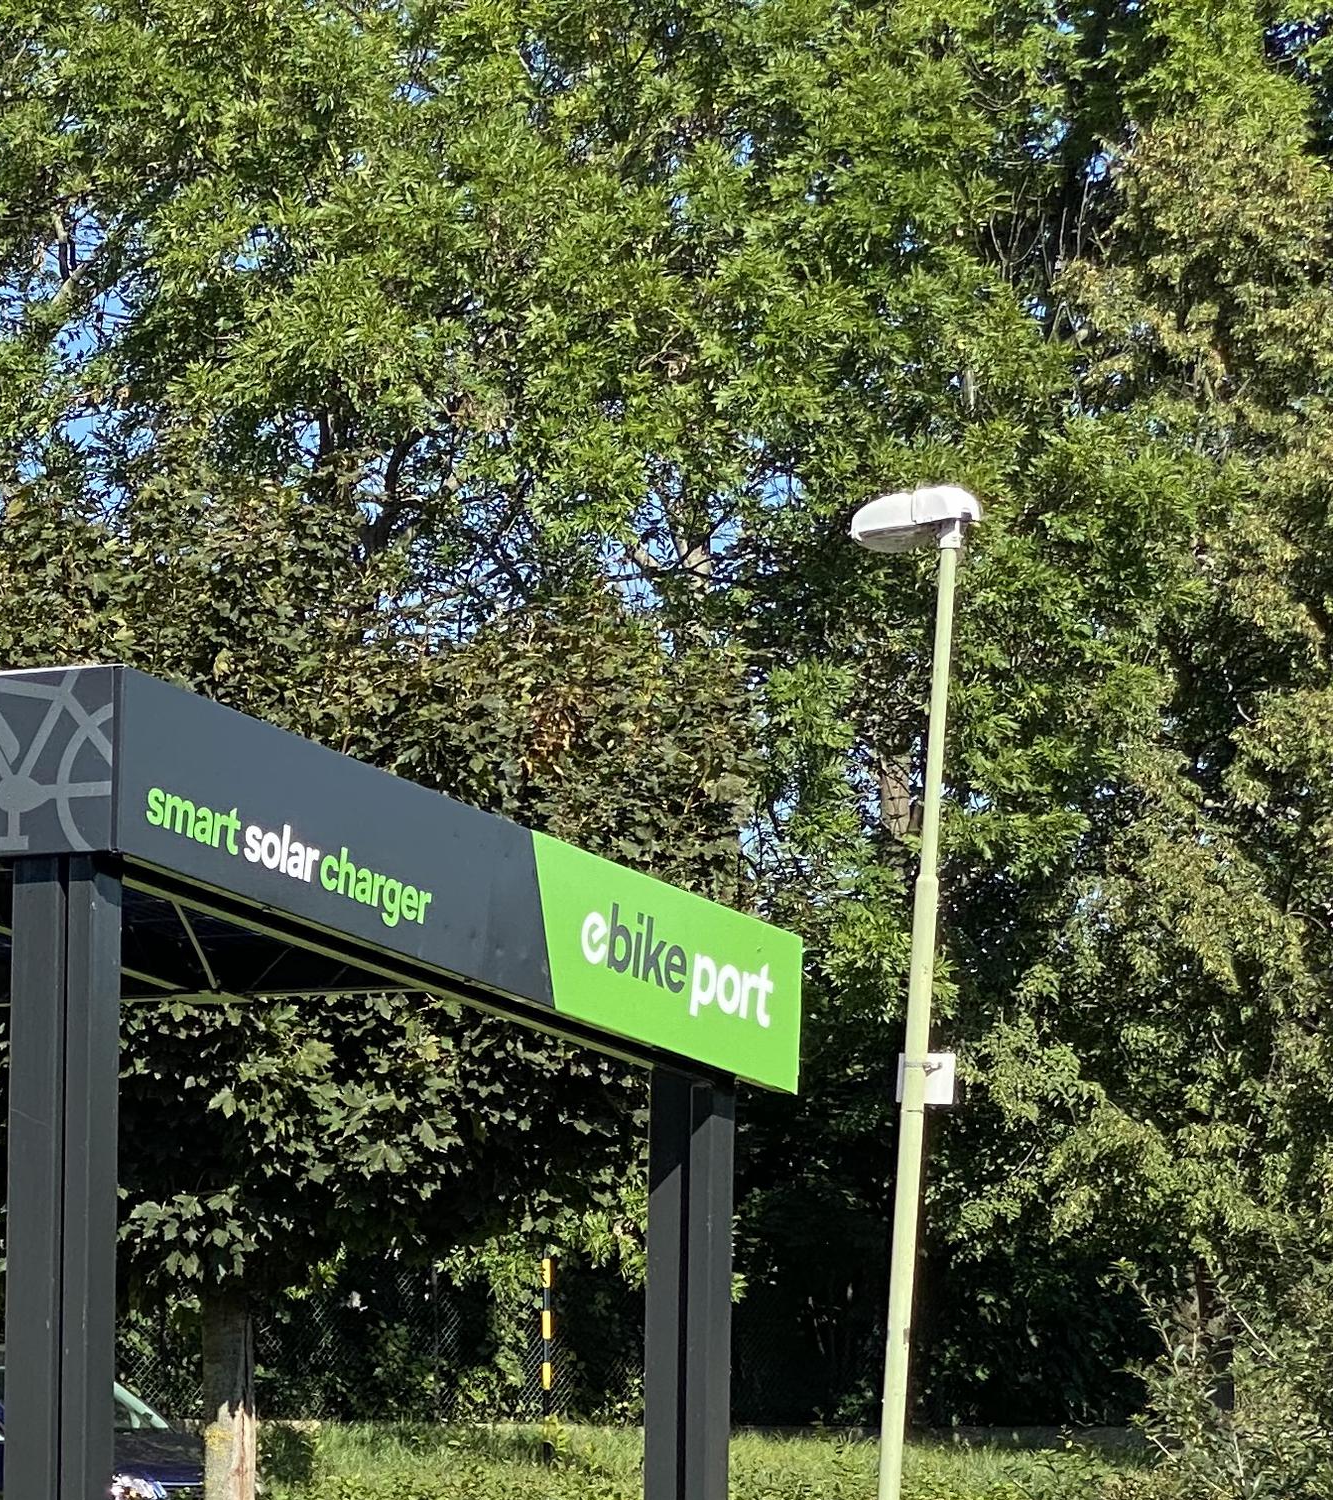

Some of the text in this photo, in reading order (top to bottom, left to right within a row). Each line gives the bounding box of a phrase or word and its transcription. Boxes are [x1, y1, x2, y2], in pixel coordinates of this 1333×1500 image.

[146, 786, 432, 928] smart solar charger
